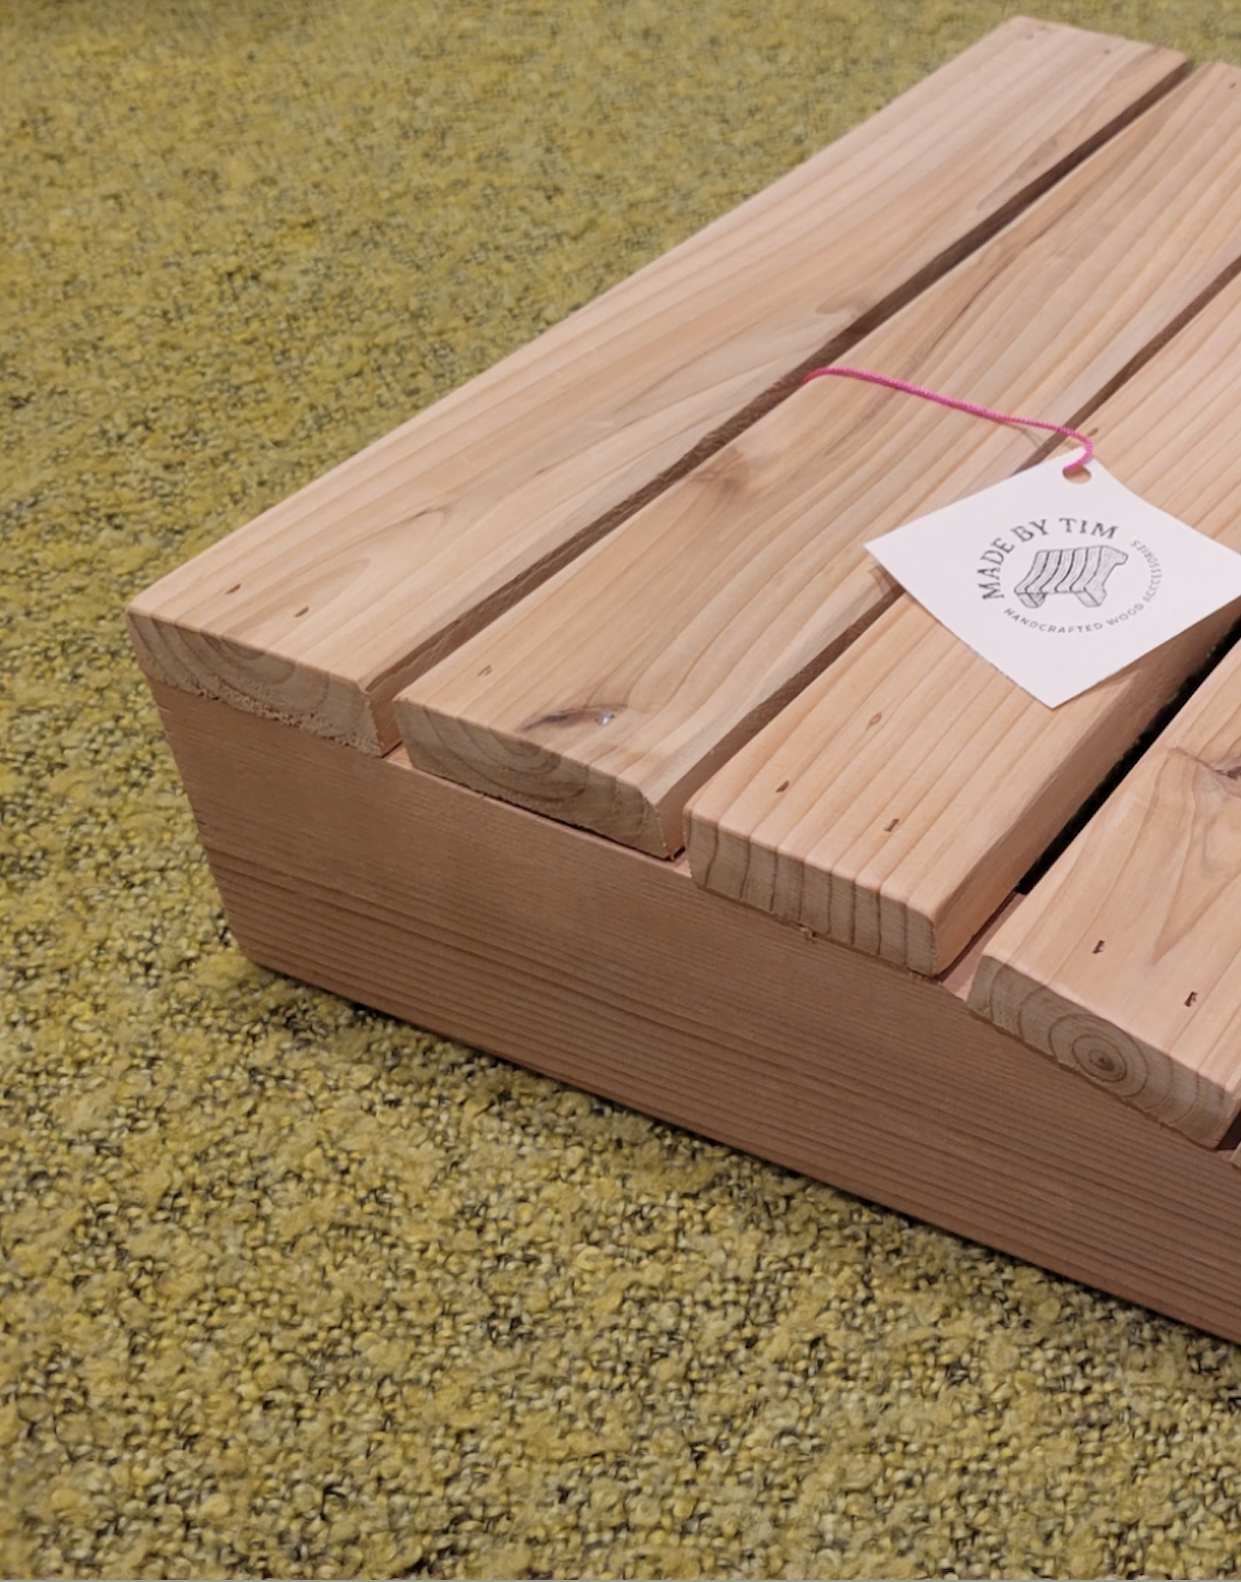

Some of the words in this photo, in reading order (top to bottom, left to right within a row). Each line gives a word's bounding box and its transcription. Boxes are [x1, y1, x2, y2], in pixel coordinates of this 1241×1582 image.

[976, 537, 1016, 601] MADE
[1010, 518, 1050, 543] BY
[1058, 517, 1120, 540] TIM
[1003, 607, 1104, 634] HANDCRAFTED
[1105, 603, 1145, 627] WOOD
